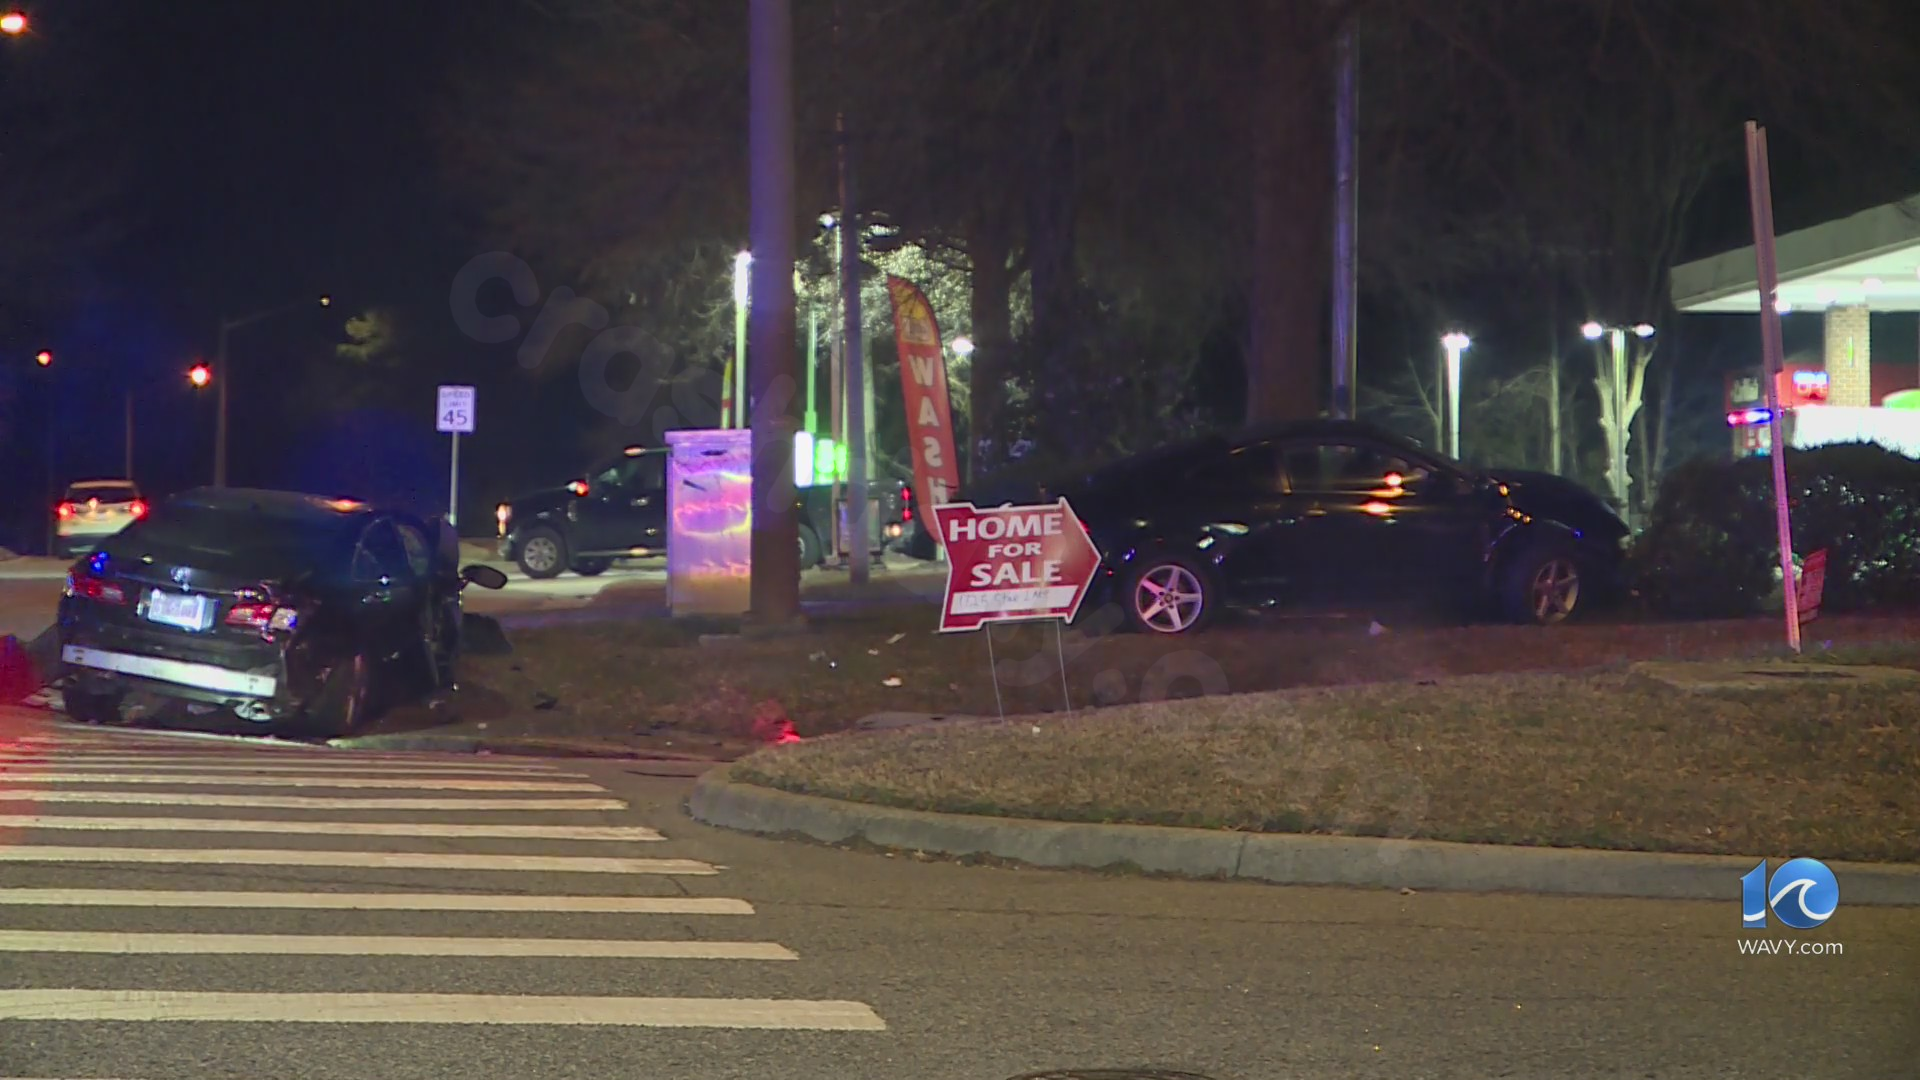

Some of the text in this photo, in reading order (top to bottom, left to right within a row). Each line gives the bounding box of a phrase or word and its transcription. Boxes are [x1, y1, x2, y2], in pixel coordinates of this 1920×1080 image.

[443, 409, 467, 425] 45
[949, 513, 1063, 542] HOME
[988, 541, 1042, 558] FOR
[970, 560, 1063, 587] SALE
